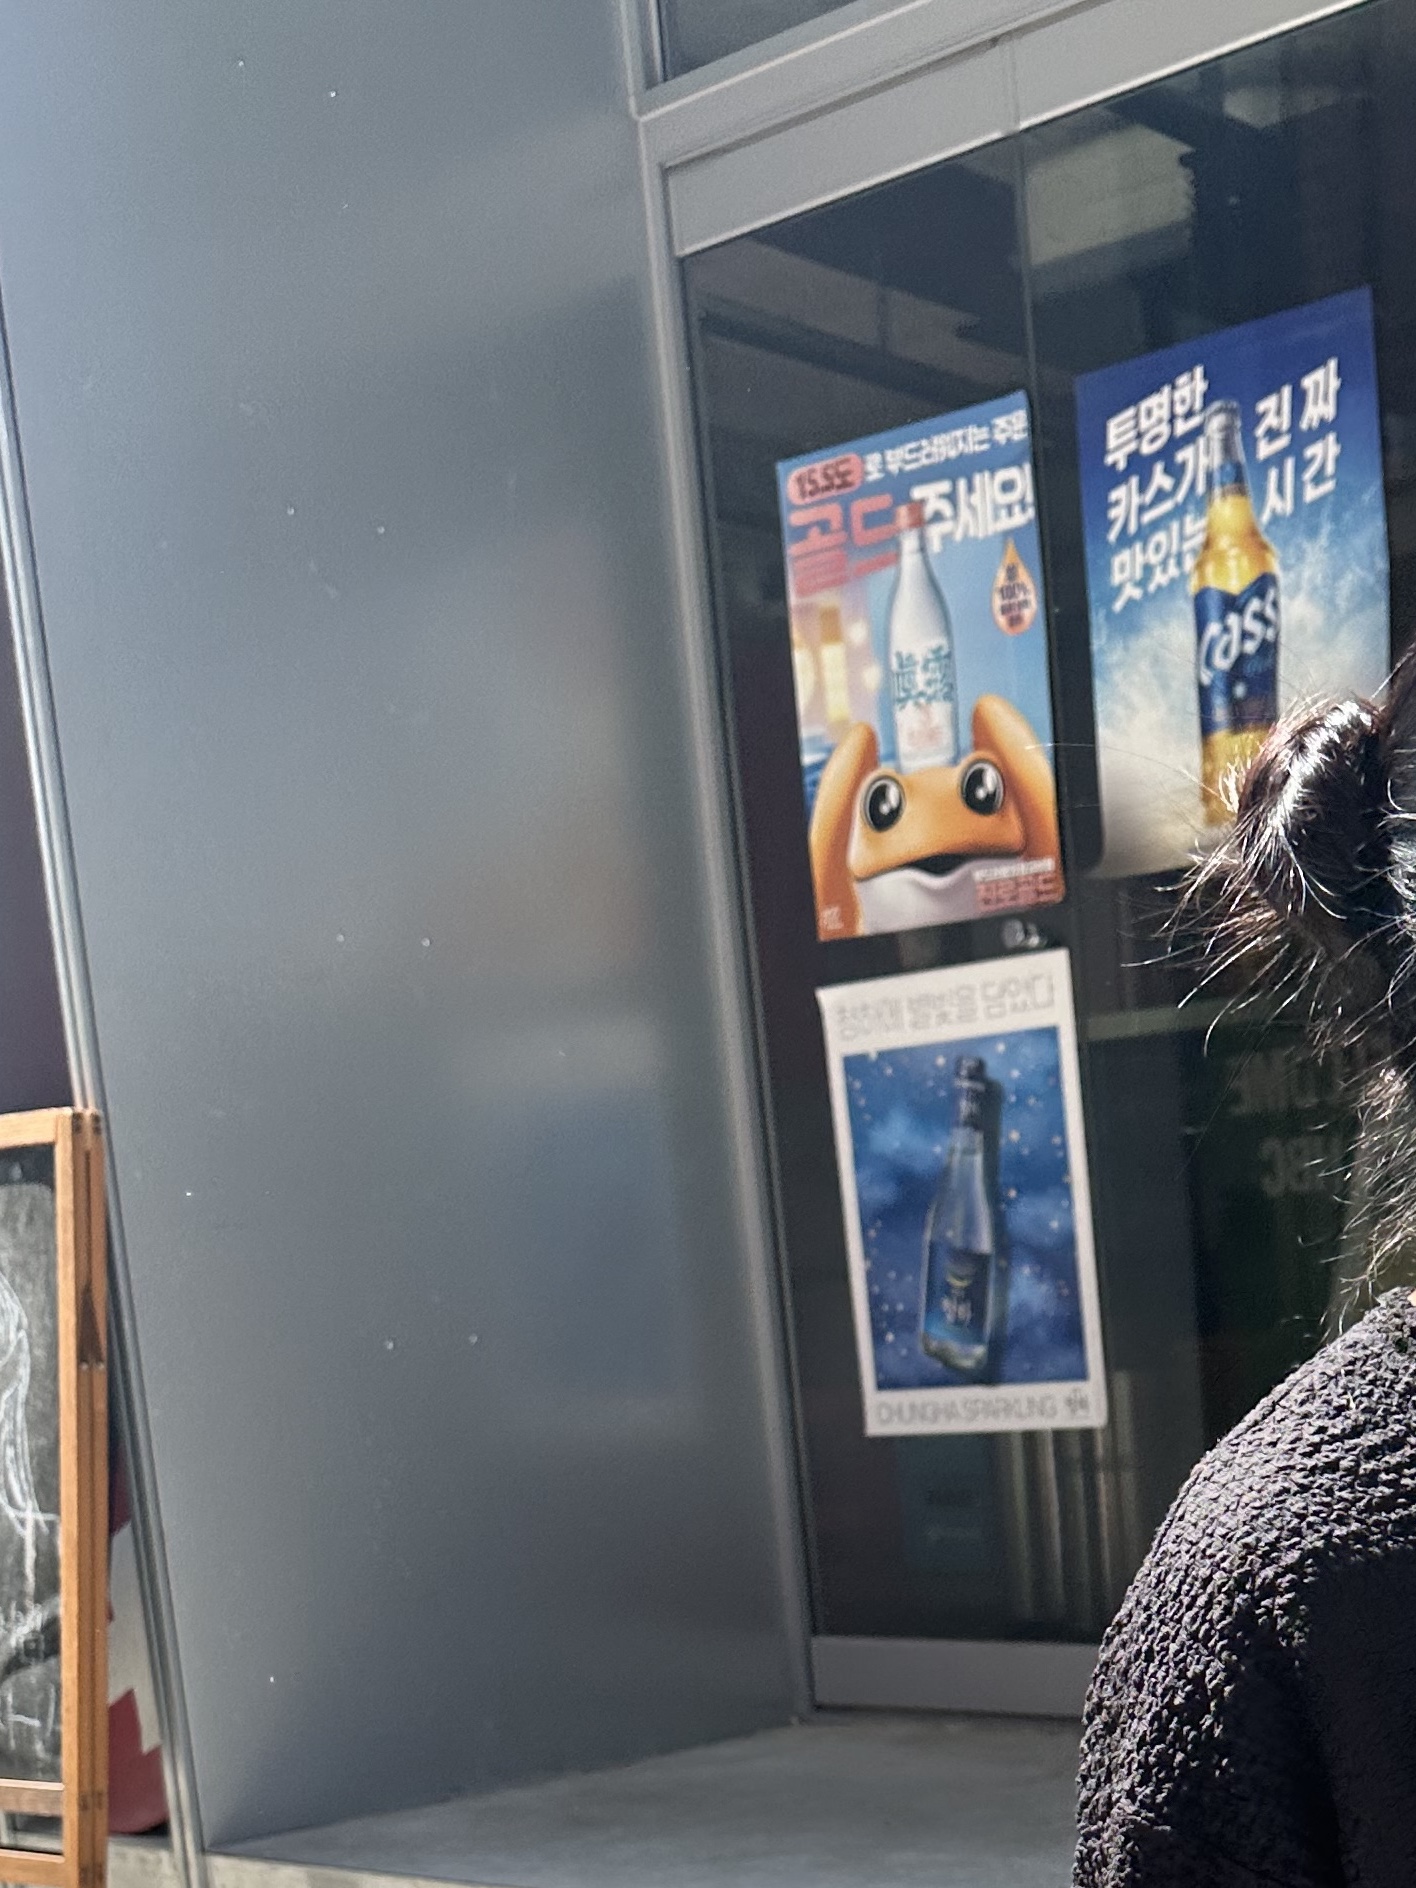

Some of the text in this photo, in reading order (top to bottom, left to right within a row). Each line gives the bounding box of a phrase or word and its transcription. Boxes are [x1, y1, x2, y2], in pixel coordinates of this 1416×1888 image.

[1104, 364, 1209, 471] 투명한
[1107, 435, 1213, 543] 카스가
[1260, 431, 1342, 525] 시간
[1200, 586, 1283, 687] Cass
